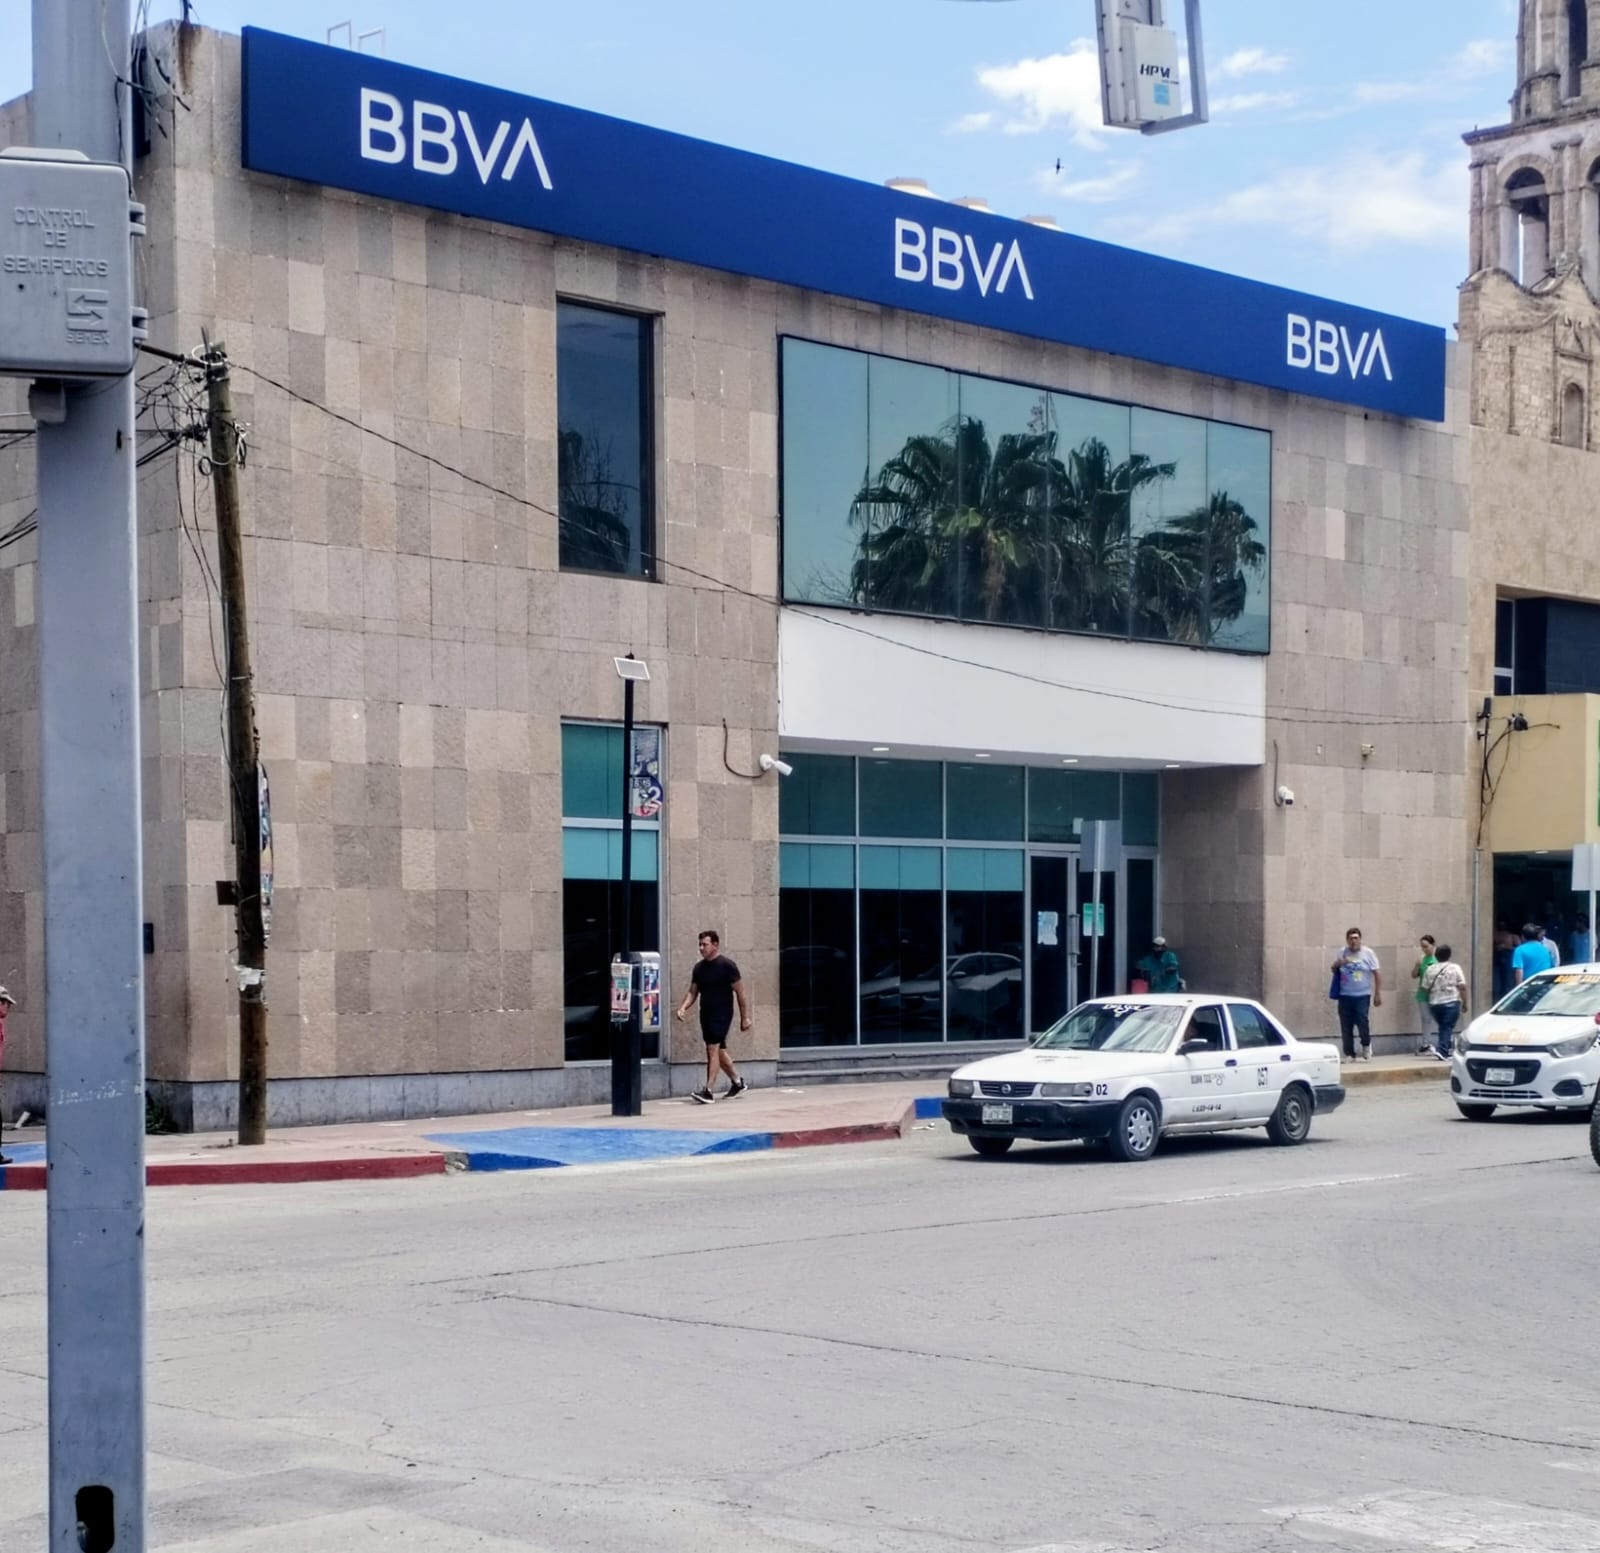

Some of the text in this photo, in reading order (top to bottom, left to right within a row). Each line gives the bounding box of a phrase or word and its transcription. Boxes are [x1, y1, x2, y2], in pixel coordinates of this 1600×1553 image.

[359, 86, 554, 191] BBVA
[13, 206, 95, 229] CONTROL
[44, 230, 67, 247] DE
[4, 254, 108, 277] SEMAFOROS
[893, 217, 1035, 301] BBVA
[1286, 312, 1394, 382] BBVA
[1096, 1083, 1108, 1096] 02
